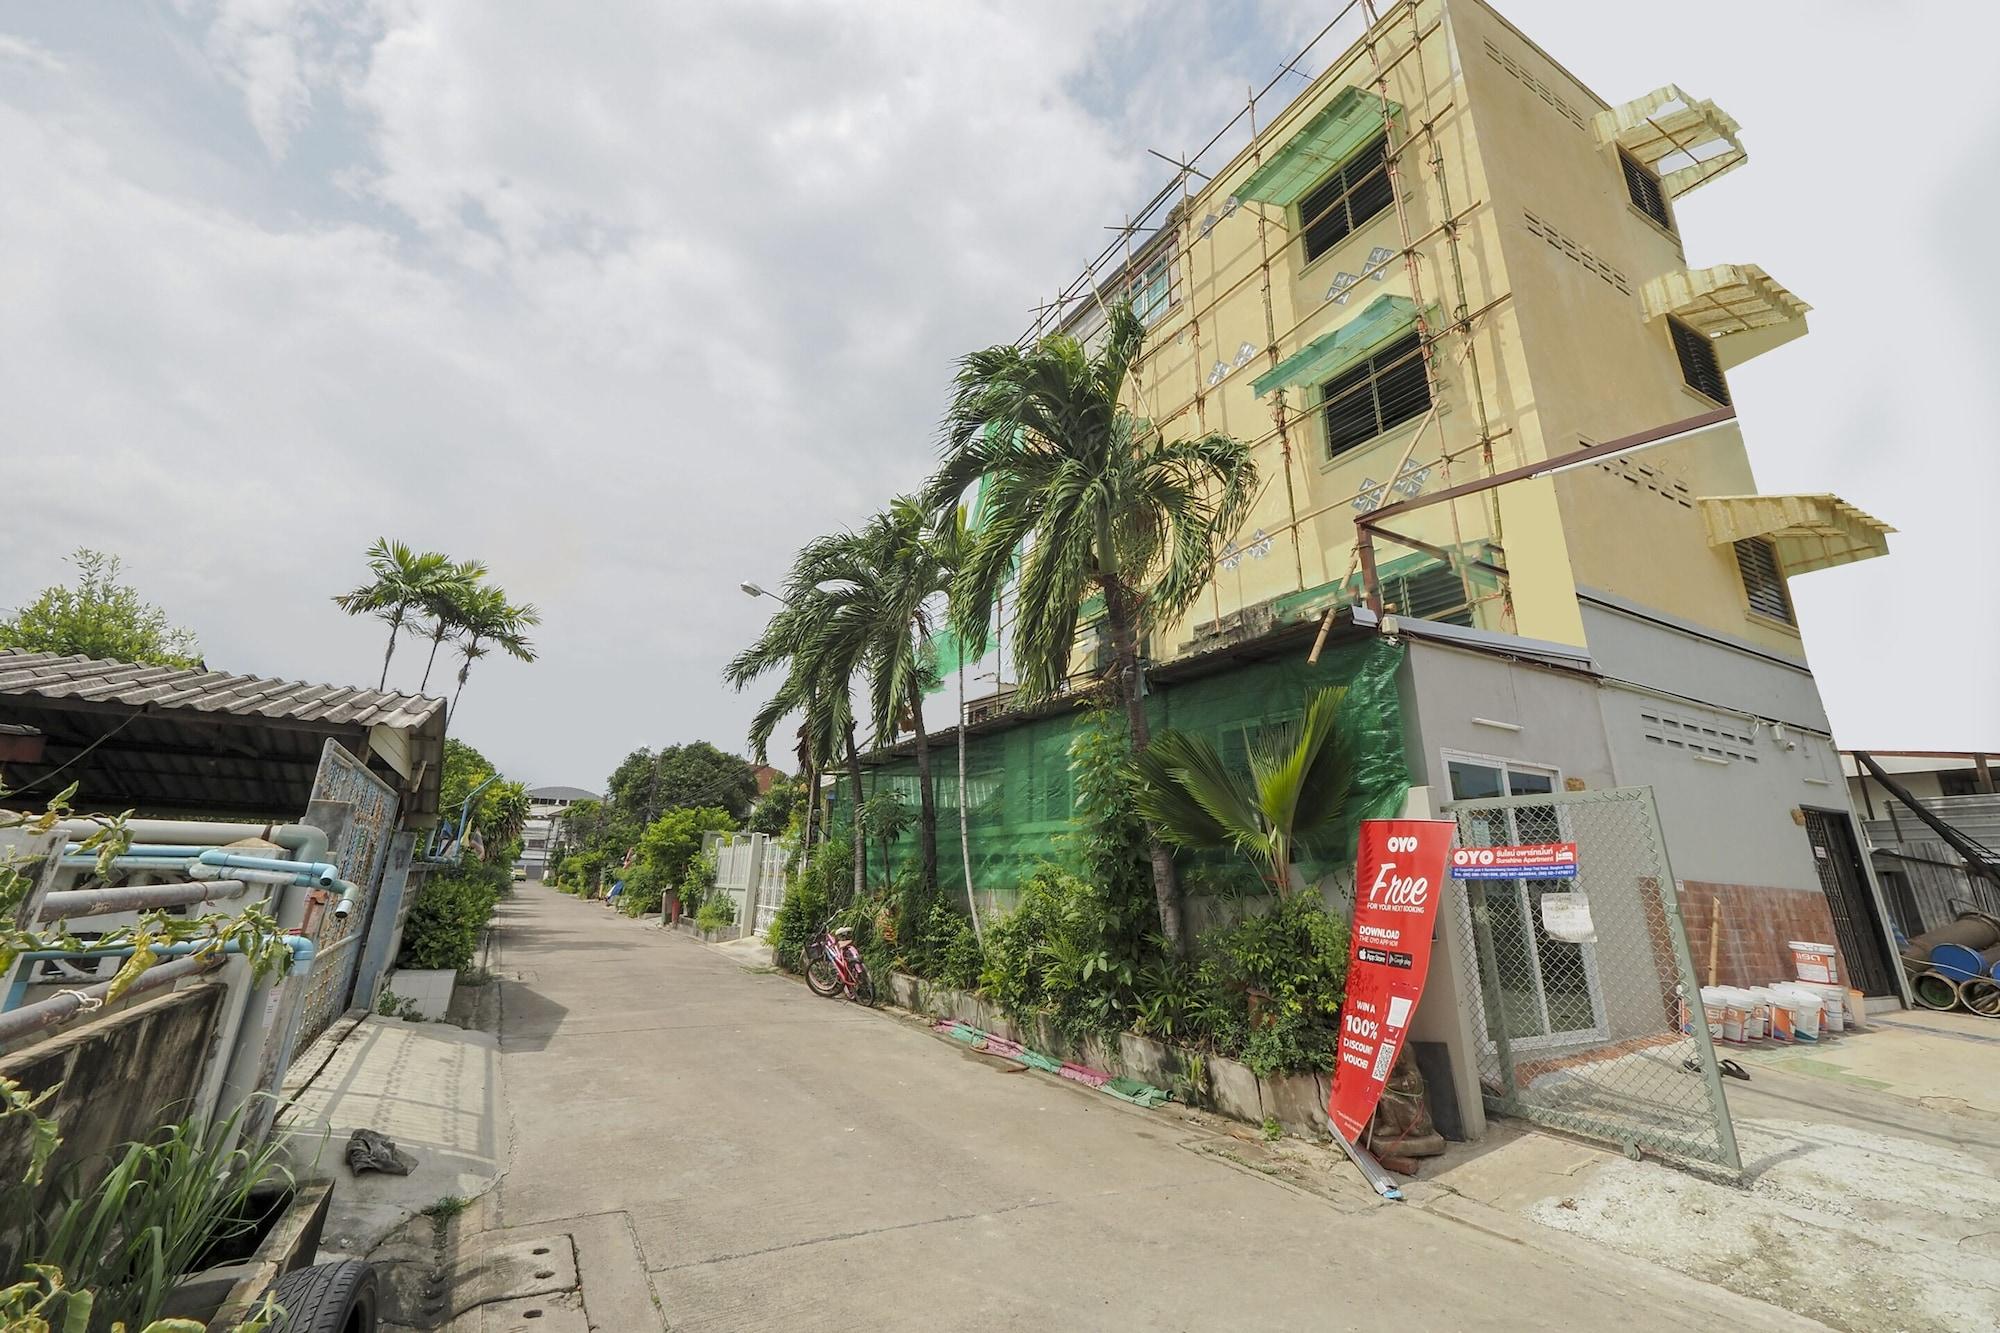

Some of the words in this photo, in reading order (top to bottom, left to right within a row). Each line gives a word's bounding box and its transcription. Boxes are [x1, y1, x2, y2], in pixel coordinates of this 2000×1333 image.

[1387, 836, 1418, 853] OYO
[1454, 850, 1494, 865] OYO
[1523, 856, 1554, 864] Apartment
[1370, 863, 1428, 905] Free
[1367, 902, 1378, 910] FOR
[1379, 903, 1391, 911] YOUR
[1359, 925, 1400, 940] DOWNLOAD
[1359, 935, 1369, 943] THE
[1369, 936, 1380, 944] OYO
[1379, 938, 1389, 946] APP
[1356, 1000, 1370, 1012] WIN
[1370, 1004, 1376, 1014] A
[1345, 1014, 1379, 1040] 100%
